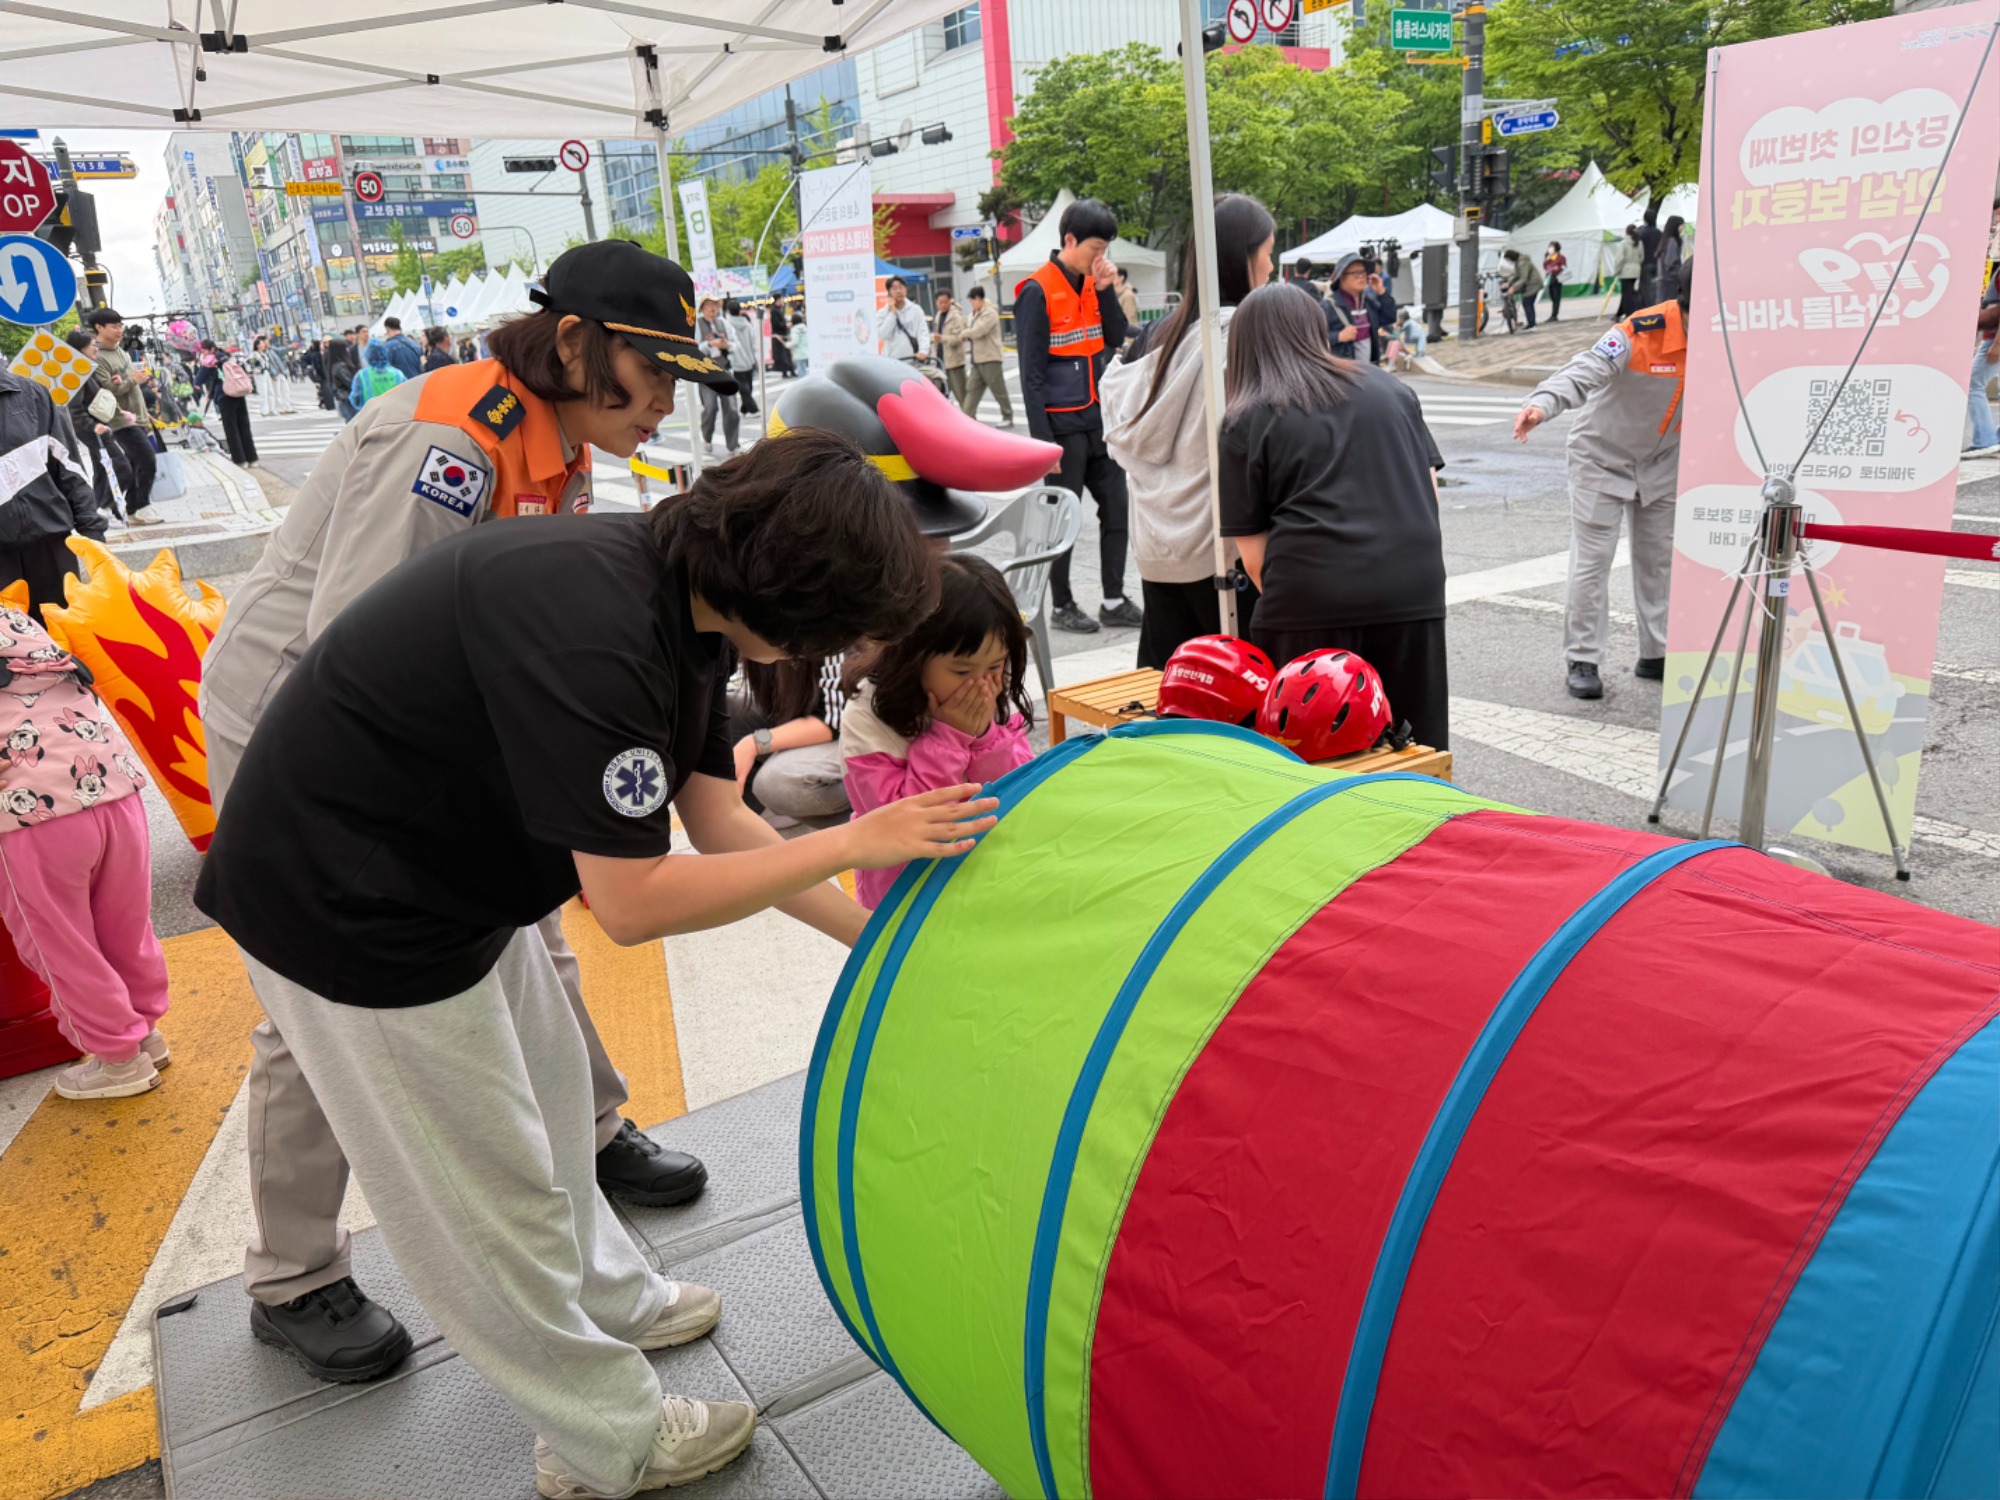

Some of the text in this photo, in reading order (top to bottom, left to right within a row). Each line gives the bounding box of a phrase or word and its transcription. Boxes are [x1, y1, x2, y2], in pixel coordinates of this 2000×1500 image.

[1395, 19, 1450, 40] 홈플러스사거리
[0, 156, 36, 187] 지
[71, 161, 107, 175] 덕3로
[361, 180, 378, 195] 50
[0, 194, 40, 218] OP
[364, 204, 405, 217] 교보증권
[456, 221, 471, 233] 50
[420, 484, 465, 511] KOREA
[1241, 669, 1269, 692] 119
